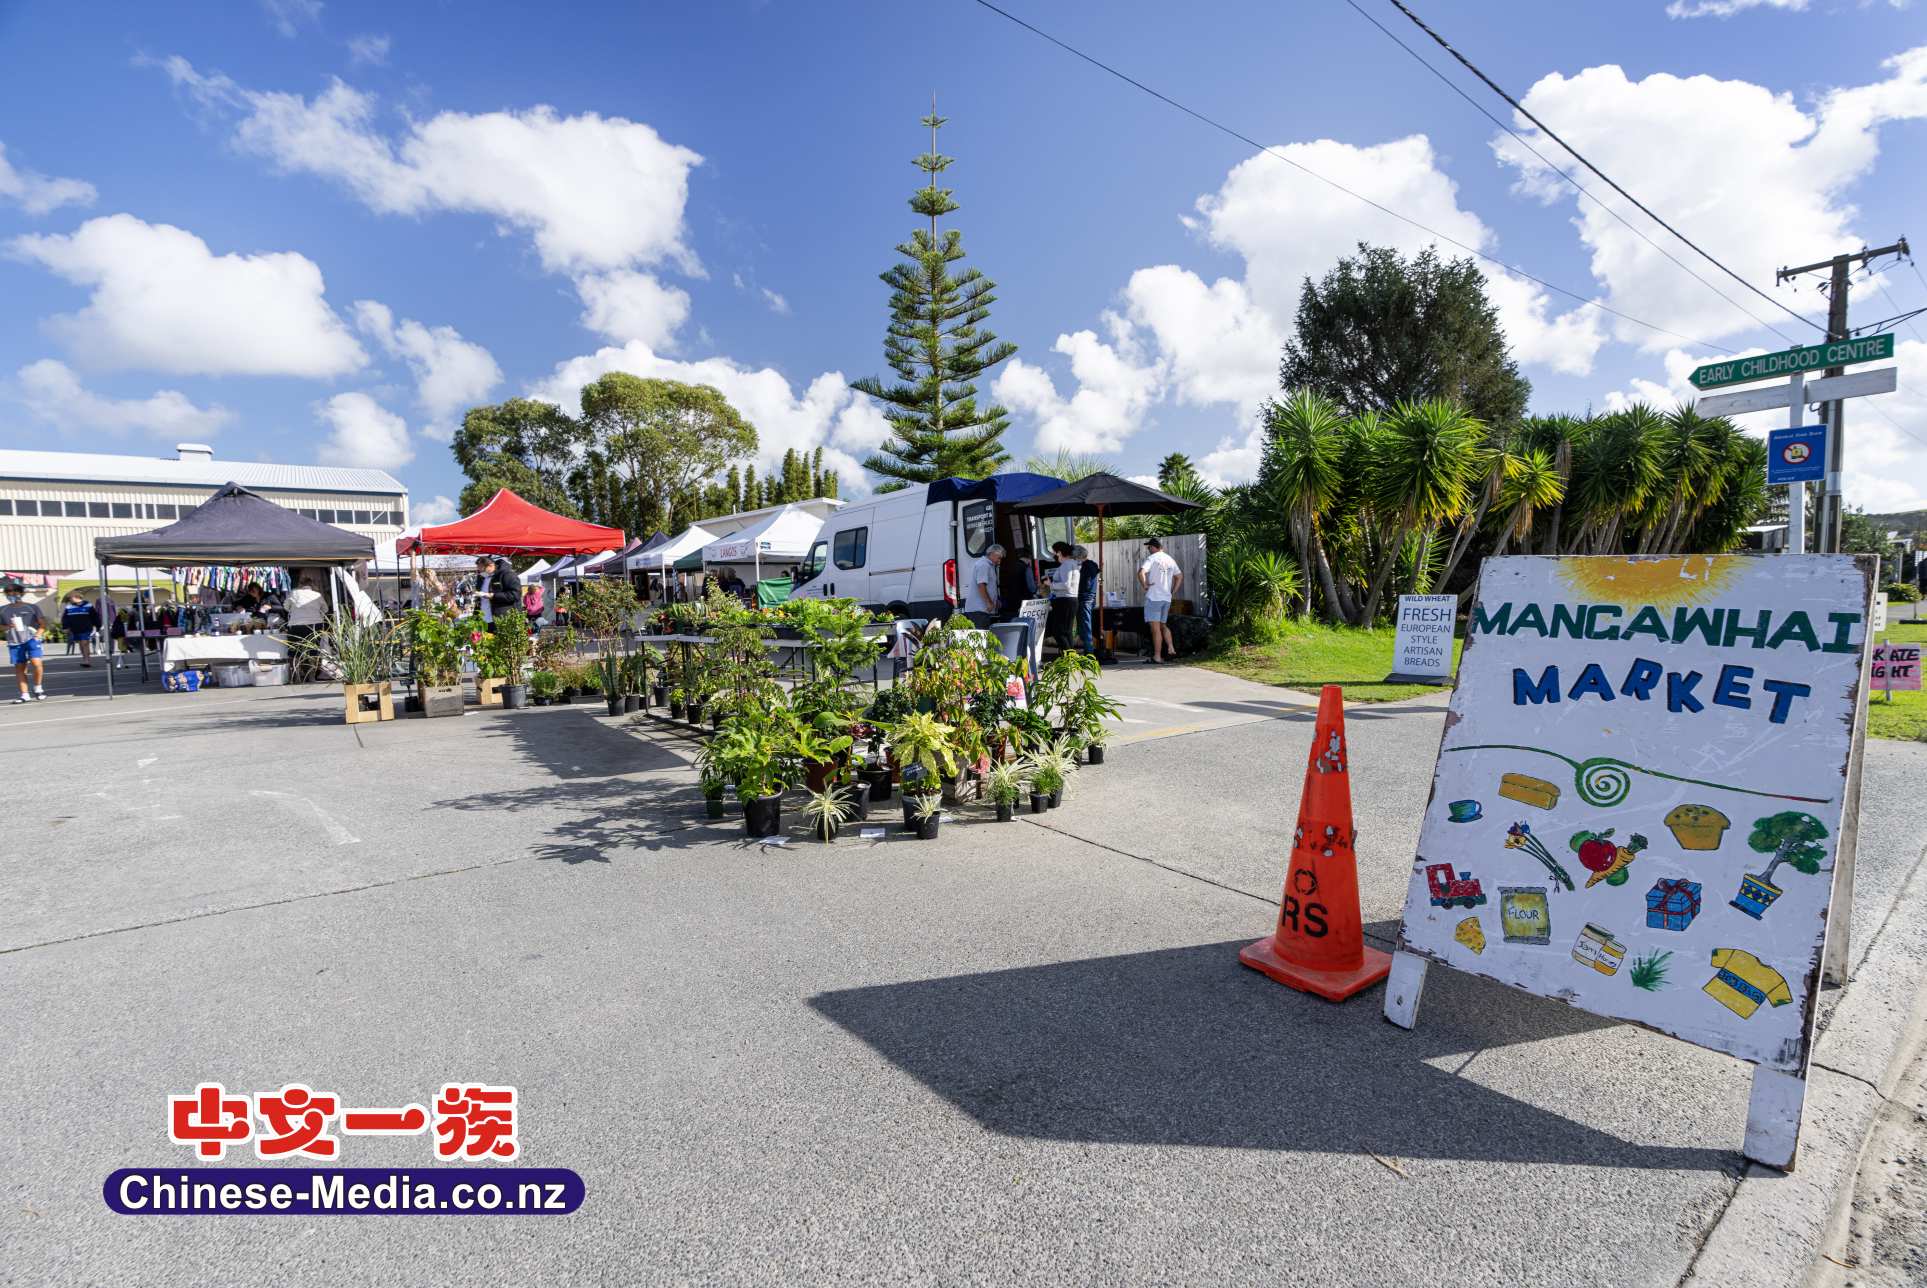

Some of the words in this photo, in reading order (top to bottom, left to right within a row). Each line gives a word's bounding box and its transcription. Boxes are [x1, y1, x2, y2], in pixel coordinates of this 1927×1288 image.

[1700, 364, 1734, 384] EARLY
[1741, 350, 1820, 377] CHILDHOOD
[1827, 338, 1885, 363] CENTRE
[1403, 607, 1452, 621] FRESH
[1401, 623, 1451, 633] EUROPEAN
[1472, 602, 1862, 653] MANGAWHAI
[1411, 635, 1438, 644] STYLE
[1403, 646, 1443, 656] ARTISAN
[1404, 657, 1441, 667] BREADS
[1513, 657, 1812, 724] MARKET
[1282, 894, 1328, 938] RS
[1508, 906, 1540, 920] FLOUR
